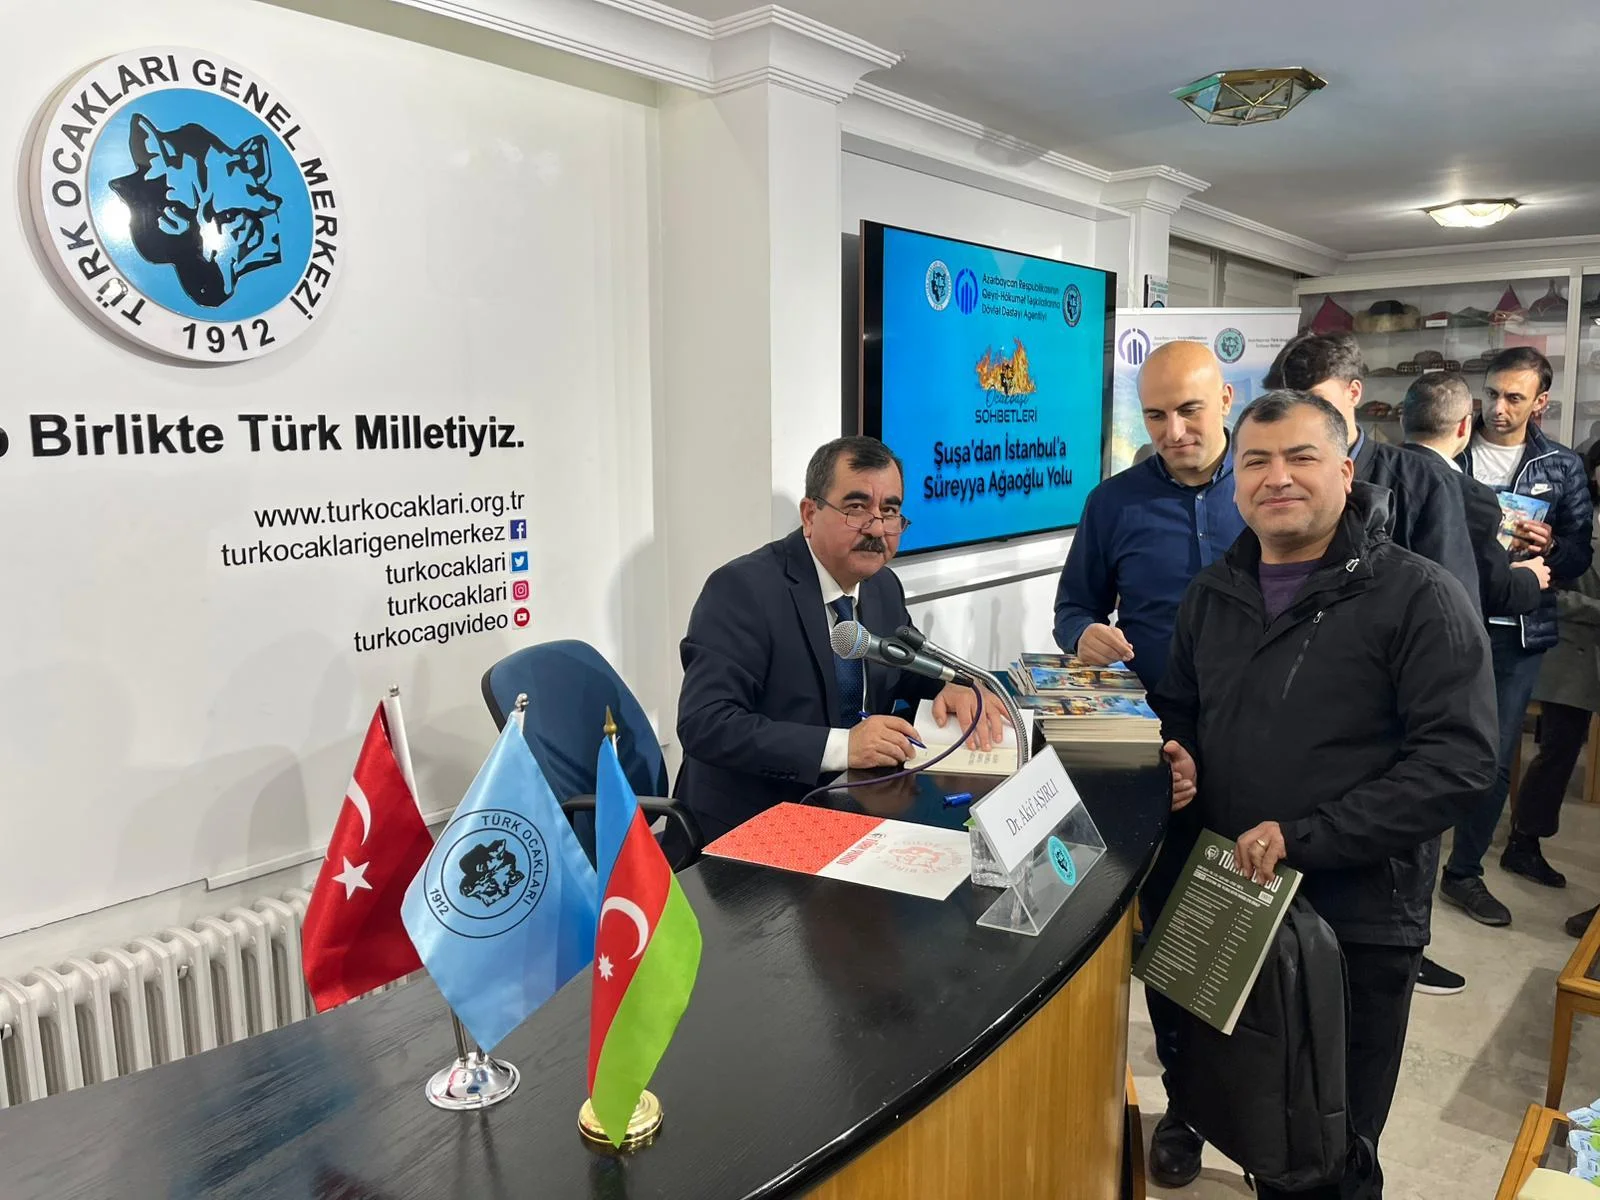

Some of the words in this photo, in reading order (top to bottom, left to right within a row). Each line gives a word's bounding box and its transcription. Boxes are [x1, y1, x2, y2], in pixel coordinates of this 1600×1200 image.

[191, 58, 302, 151] GENEL
[51, 54, 180, 208] OCAKLARI
[289, 157, 339, 320] MERKEZİ
[60, 220, 147, 326] TÜRK
[182, 317, 276, 354] 1912
[29, 413, 225, 458] Birlikte
[238, 413, 343, 452] Türk
[355, 414, 525, 458] Milletiyiz.
[975, 406, 1038, 424] SOHBETLERİ
[934, 438, 1001, 471] Şuşa'dan
[1005, 432, 1067, 461] İstanbul'a
[924, 474, 985, 501] Süreyya
[988, 467, 1044, 498] Ağaoğlu
[1047, 464, 1073, 487] Yolu
[254, 490, 525, 529] www.turkocaklari.org.tr
[222, 524, 506, 567] turkocaklarigenelmerkez
[385, 552, 507, 586] turkocaklari
[387, 581, 508, 617] turkocaklari
[353, 612, 509, 653] turkocagıvideo
[1005, 817, 1023, 837] Dr.
[1018, 797, 1037, 826] Akif
[1032, 778, 1059, 810] AŞIRLI
[481, 812, 523, 833] TÜRK
[521, 829, 544, 906] OCAKLARI
[429, 887, 450, 917] 1912
